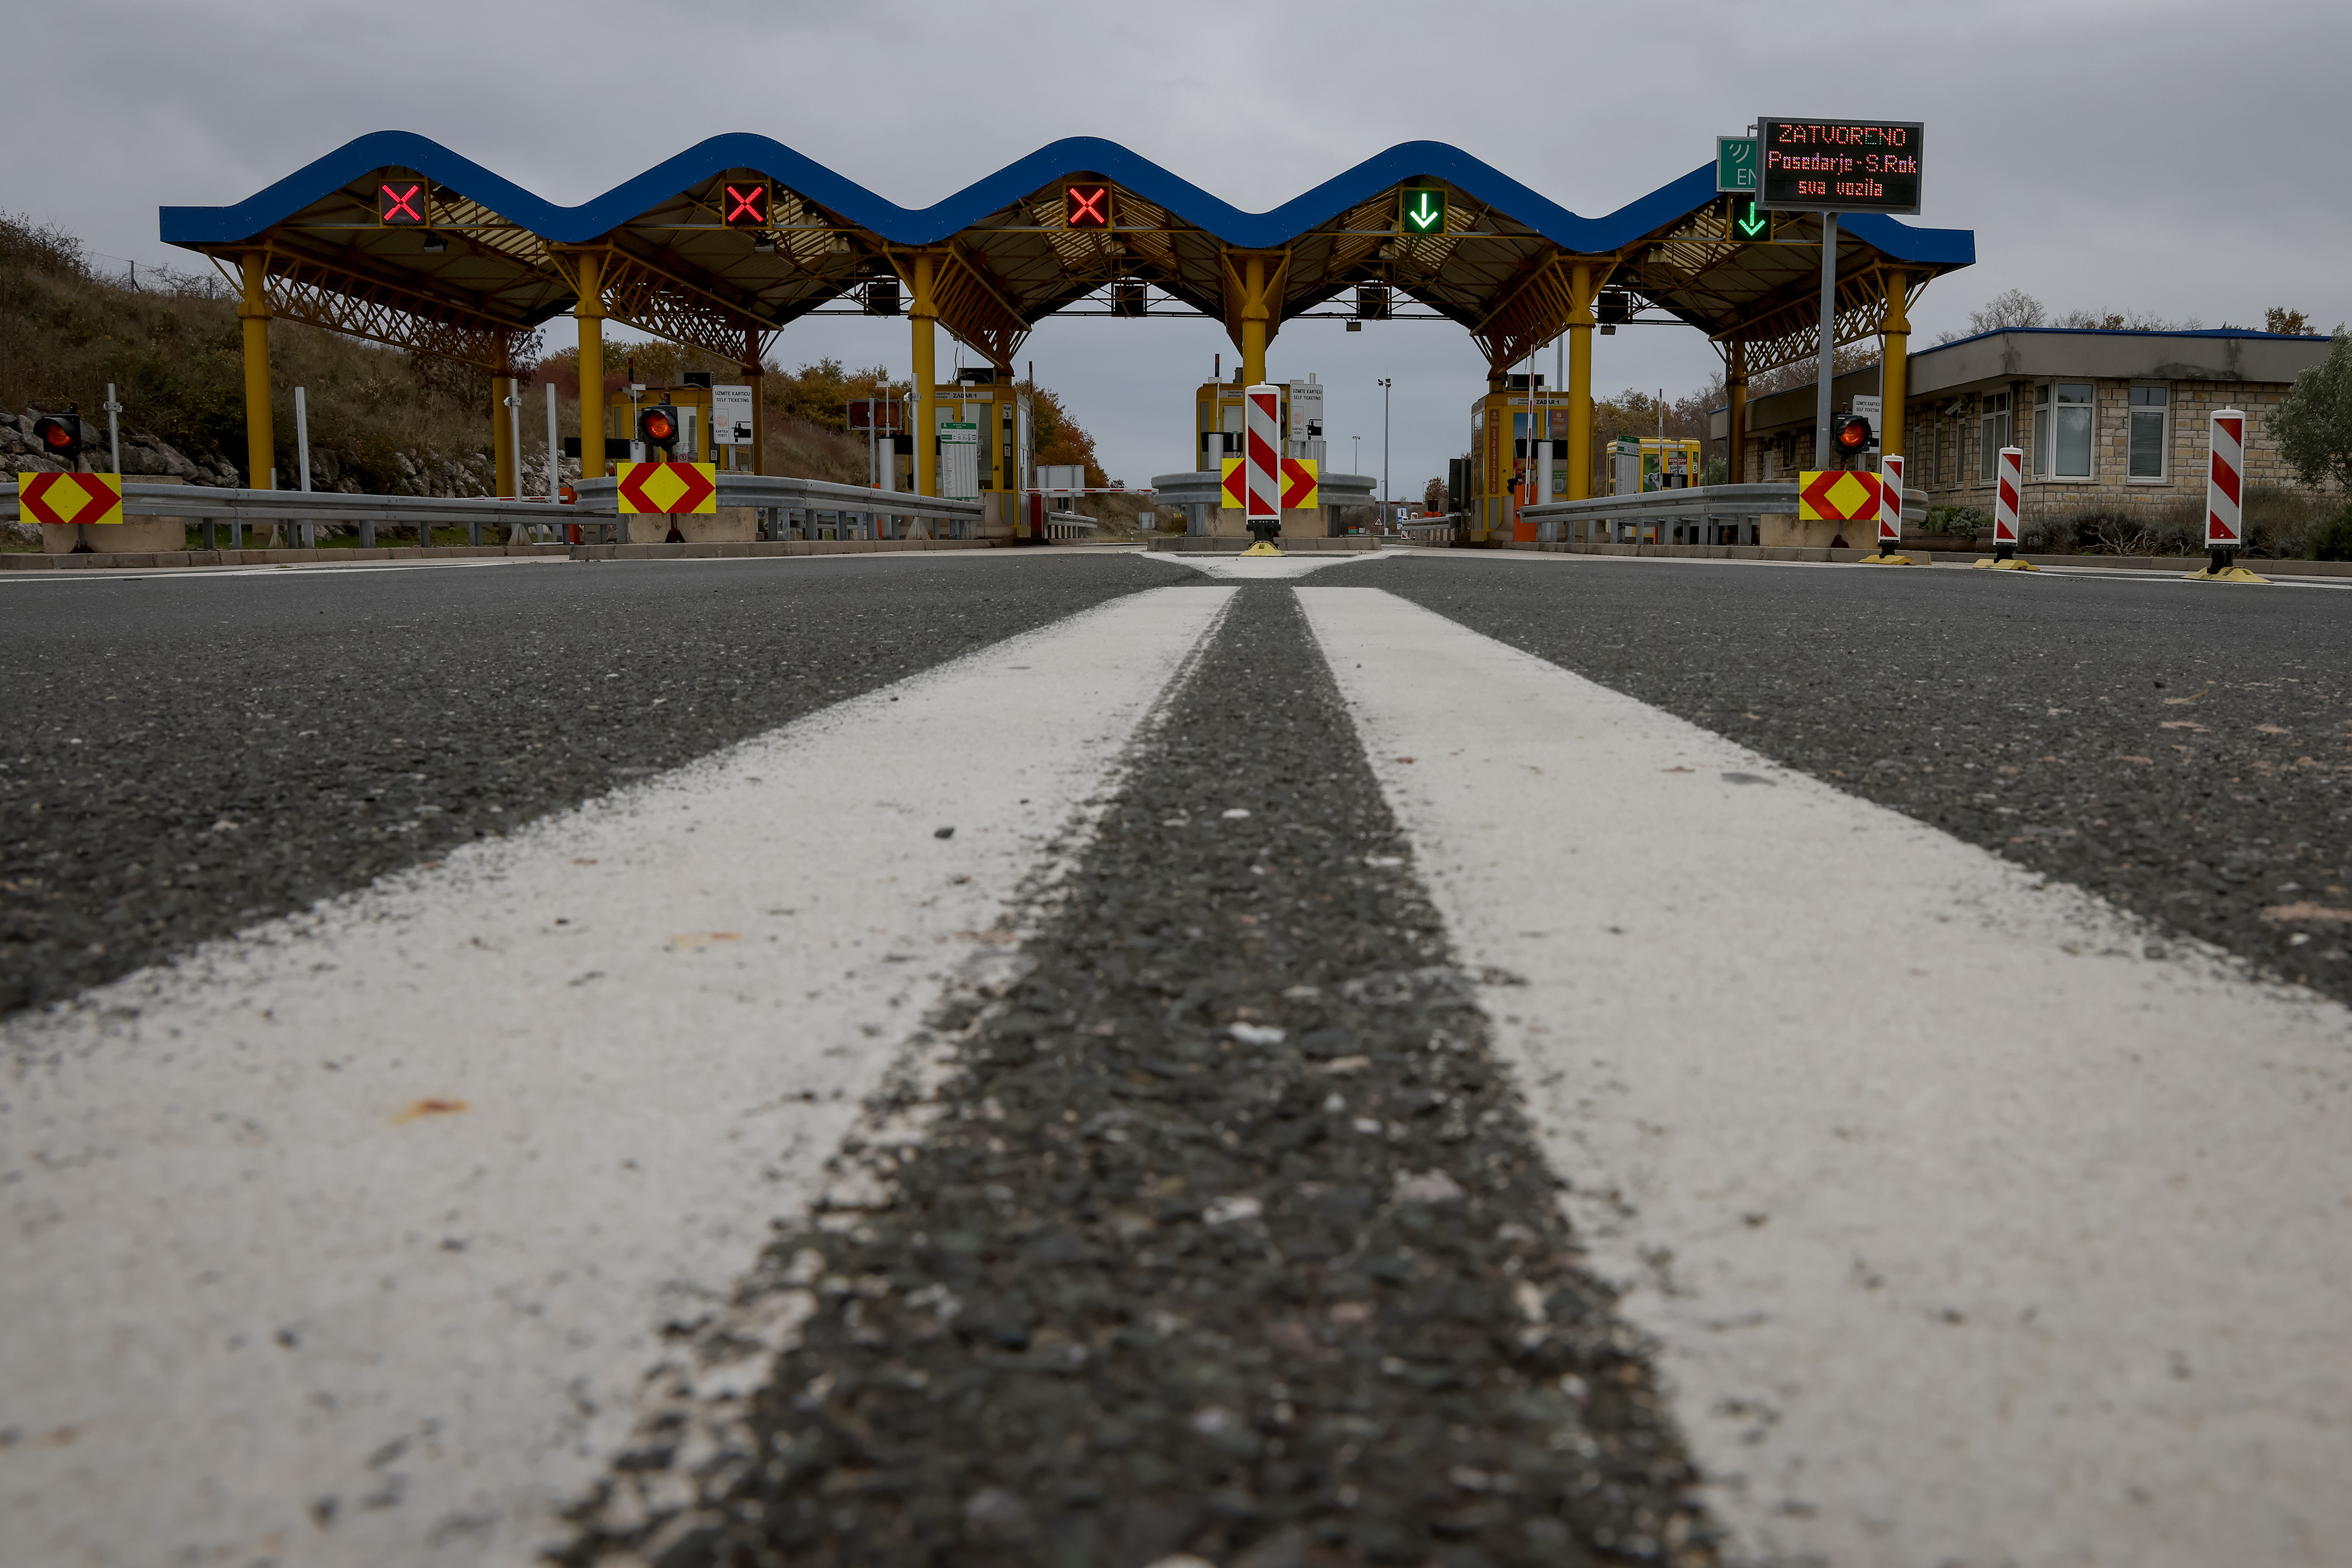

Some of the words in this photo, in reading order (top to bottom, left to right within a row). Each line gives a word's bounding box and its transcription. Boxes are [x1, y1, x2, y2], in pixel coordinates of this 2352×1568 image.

[1778, 124, 1906, 146] ZATVORENO
[1738, 168, 1756, 185] EN
[1798, 180, 1825, 195] sva
[1836, 178, 1883, 197] vozila
